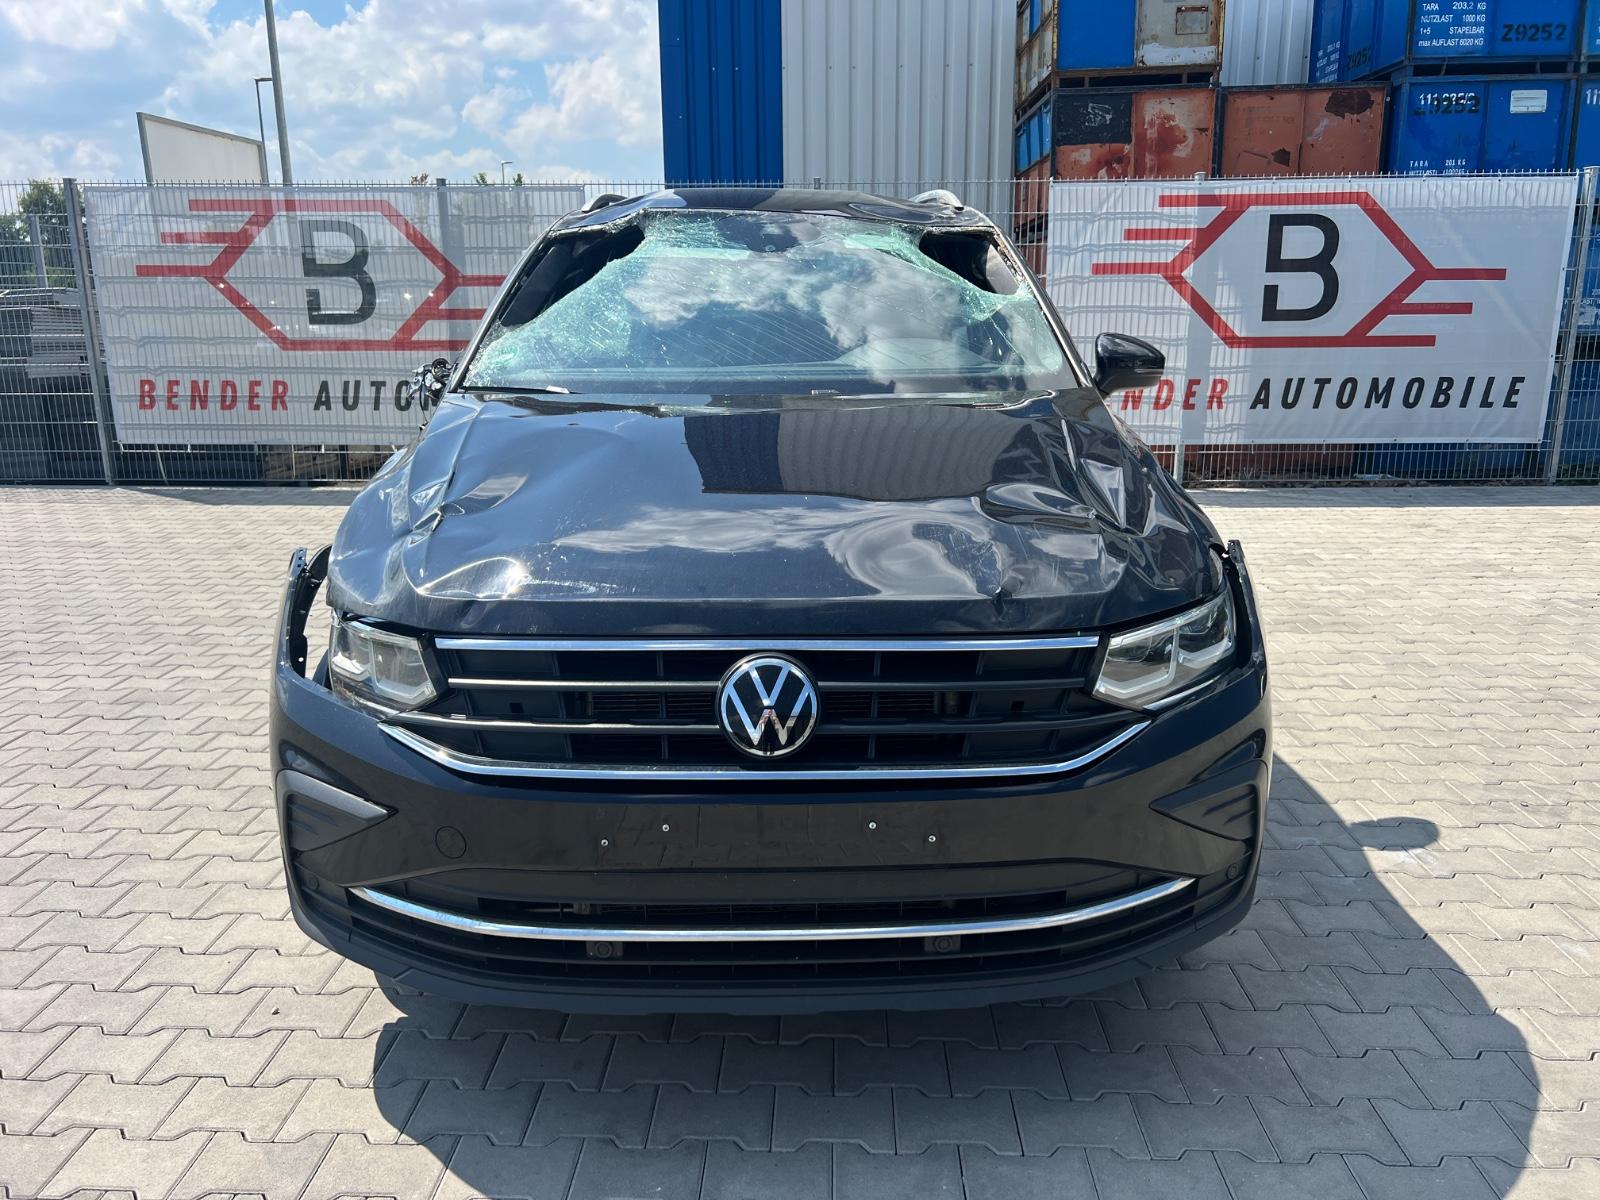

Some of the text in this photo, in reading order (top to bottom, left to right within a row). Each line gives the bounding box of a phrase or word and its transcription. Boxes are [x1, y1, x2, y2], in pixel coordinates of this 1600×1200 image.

[1422, 1, 1487, 11] TARA 203.2 KG
[1420, 14, 1486, 23] NUTZLAST 1000 KG
[1449, 26, 1485, 34] STAPELBAR
[1501, 23, 1568, 42] Z9252
[1431, 38, 1459, 47] AUFLAST
[1474, 38, 1484, 46] KG
[299, 219, 377, 325] B
[1261, 213, 1340, 321] B
[138, 379, 289, 411] BENDER
[1106, 376, 1527, 411] NDER AUTOMOBILE
